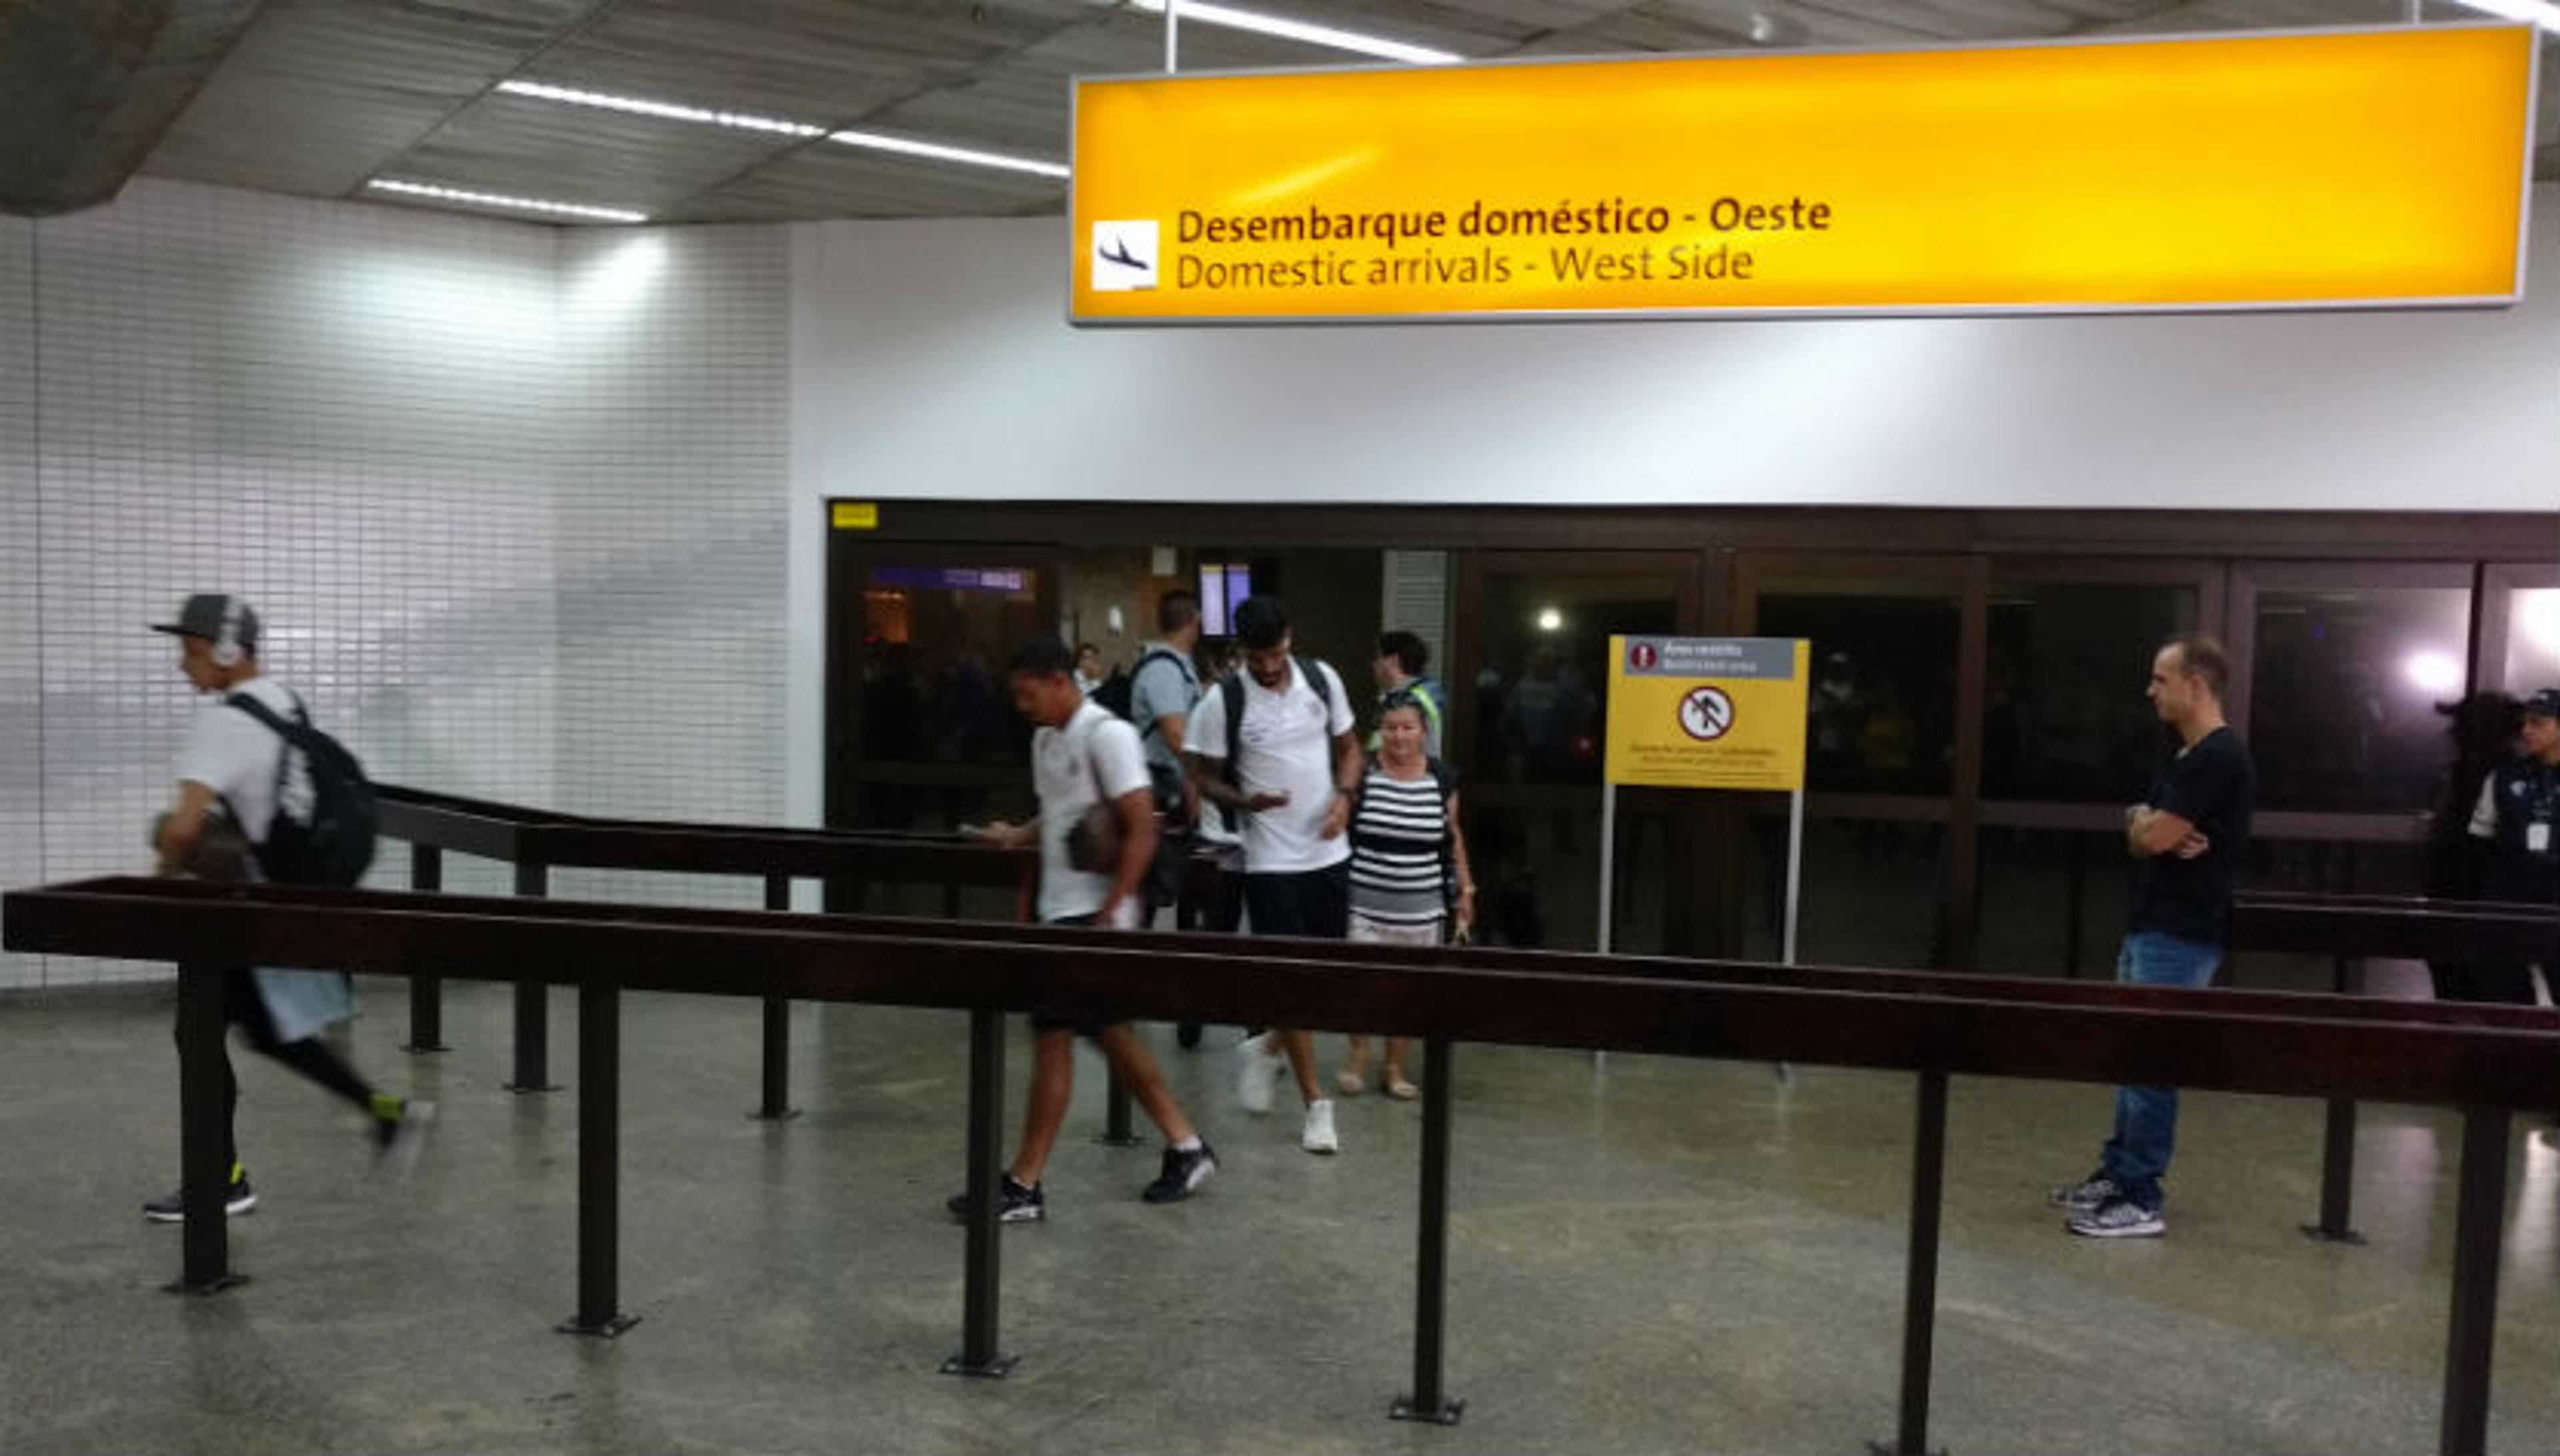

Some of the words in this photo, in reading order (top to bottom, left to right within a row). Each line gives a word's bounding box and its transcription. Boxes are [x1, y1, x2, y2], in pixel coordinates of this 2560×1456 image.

[1177, 204, 1447, 250] Desembarque
[1457, 197, 1671, 238] doméstico
[1709, 196, 1832, 233] Oeste
[1177, 251, 1355, 290] Domestic
[1367, 247, 1512, 285] arrivals
[1549, 247, 1654, 282] West
[1667, 245, 1755, 281] Side
